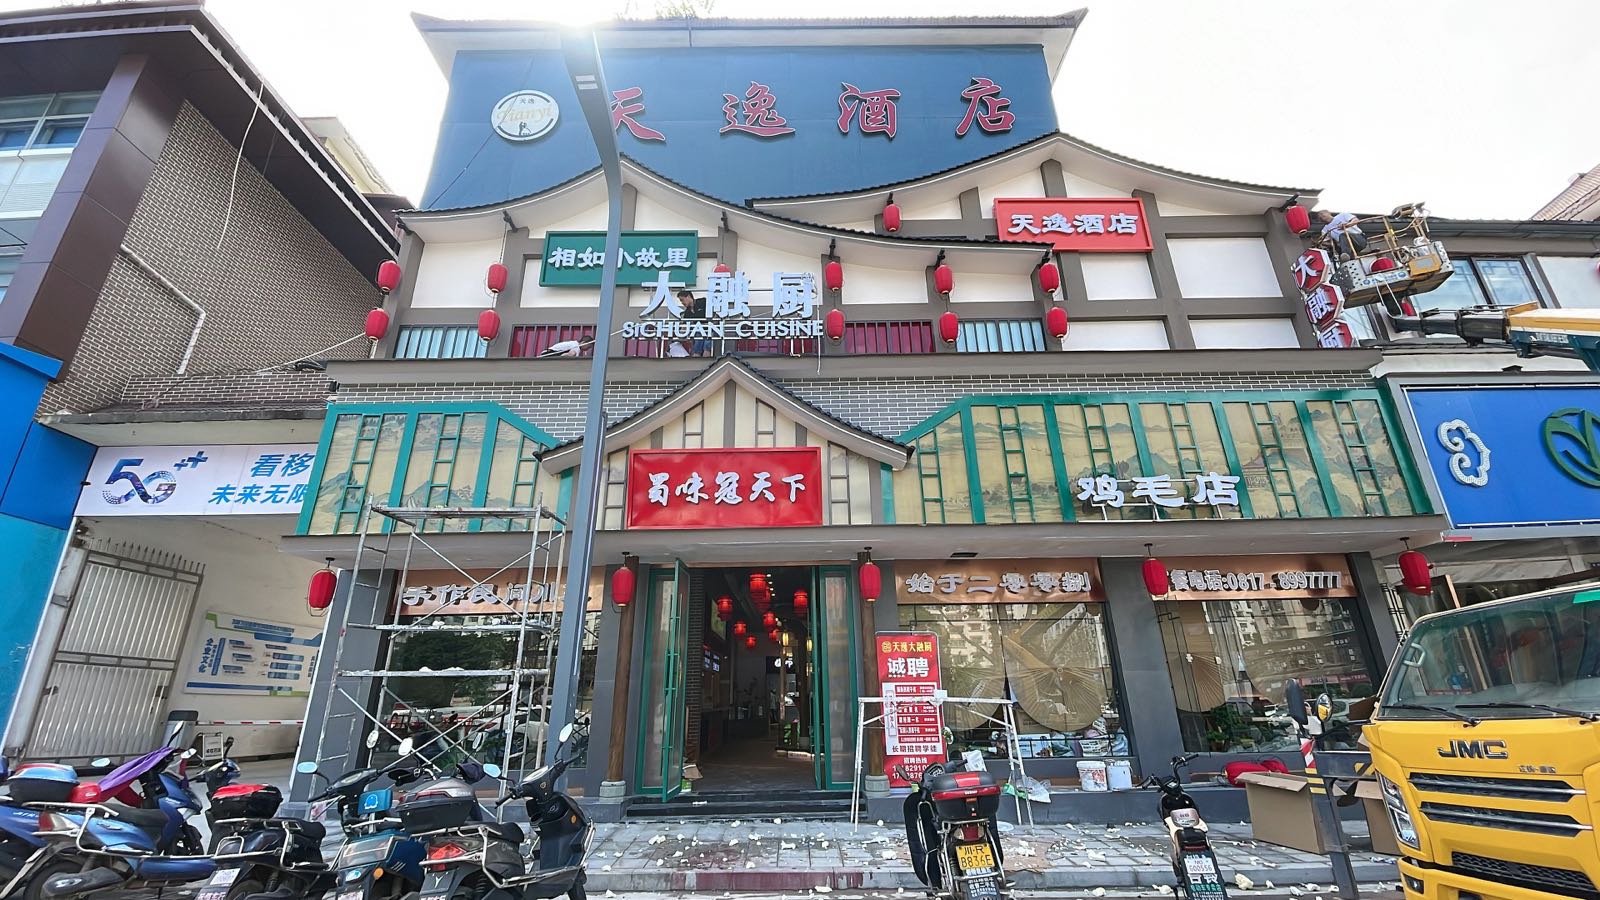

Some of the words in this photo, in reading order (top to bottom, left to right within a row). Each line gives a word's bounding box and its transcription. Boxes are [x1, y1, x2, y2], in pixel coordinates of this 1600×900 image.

[609, 77, 1017, 143] 天逸酒店
[1007, 212, 1139, 235] 天逸酒店
[640, 271, 815, 319] 大融厨
[736, 319, 823, 338] CUISINE
[648, 471, 806, 506] 蜀味冠天下
[1077, 472, 1241, 508] 鸡毛店
[905, 571, 1092, 594] 始于二零零捌
[402, 583, 566, 606] 手作民间川
[887, 657, 929, 678] 诚聘
[1437, 740, 1508, 759] JMC
